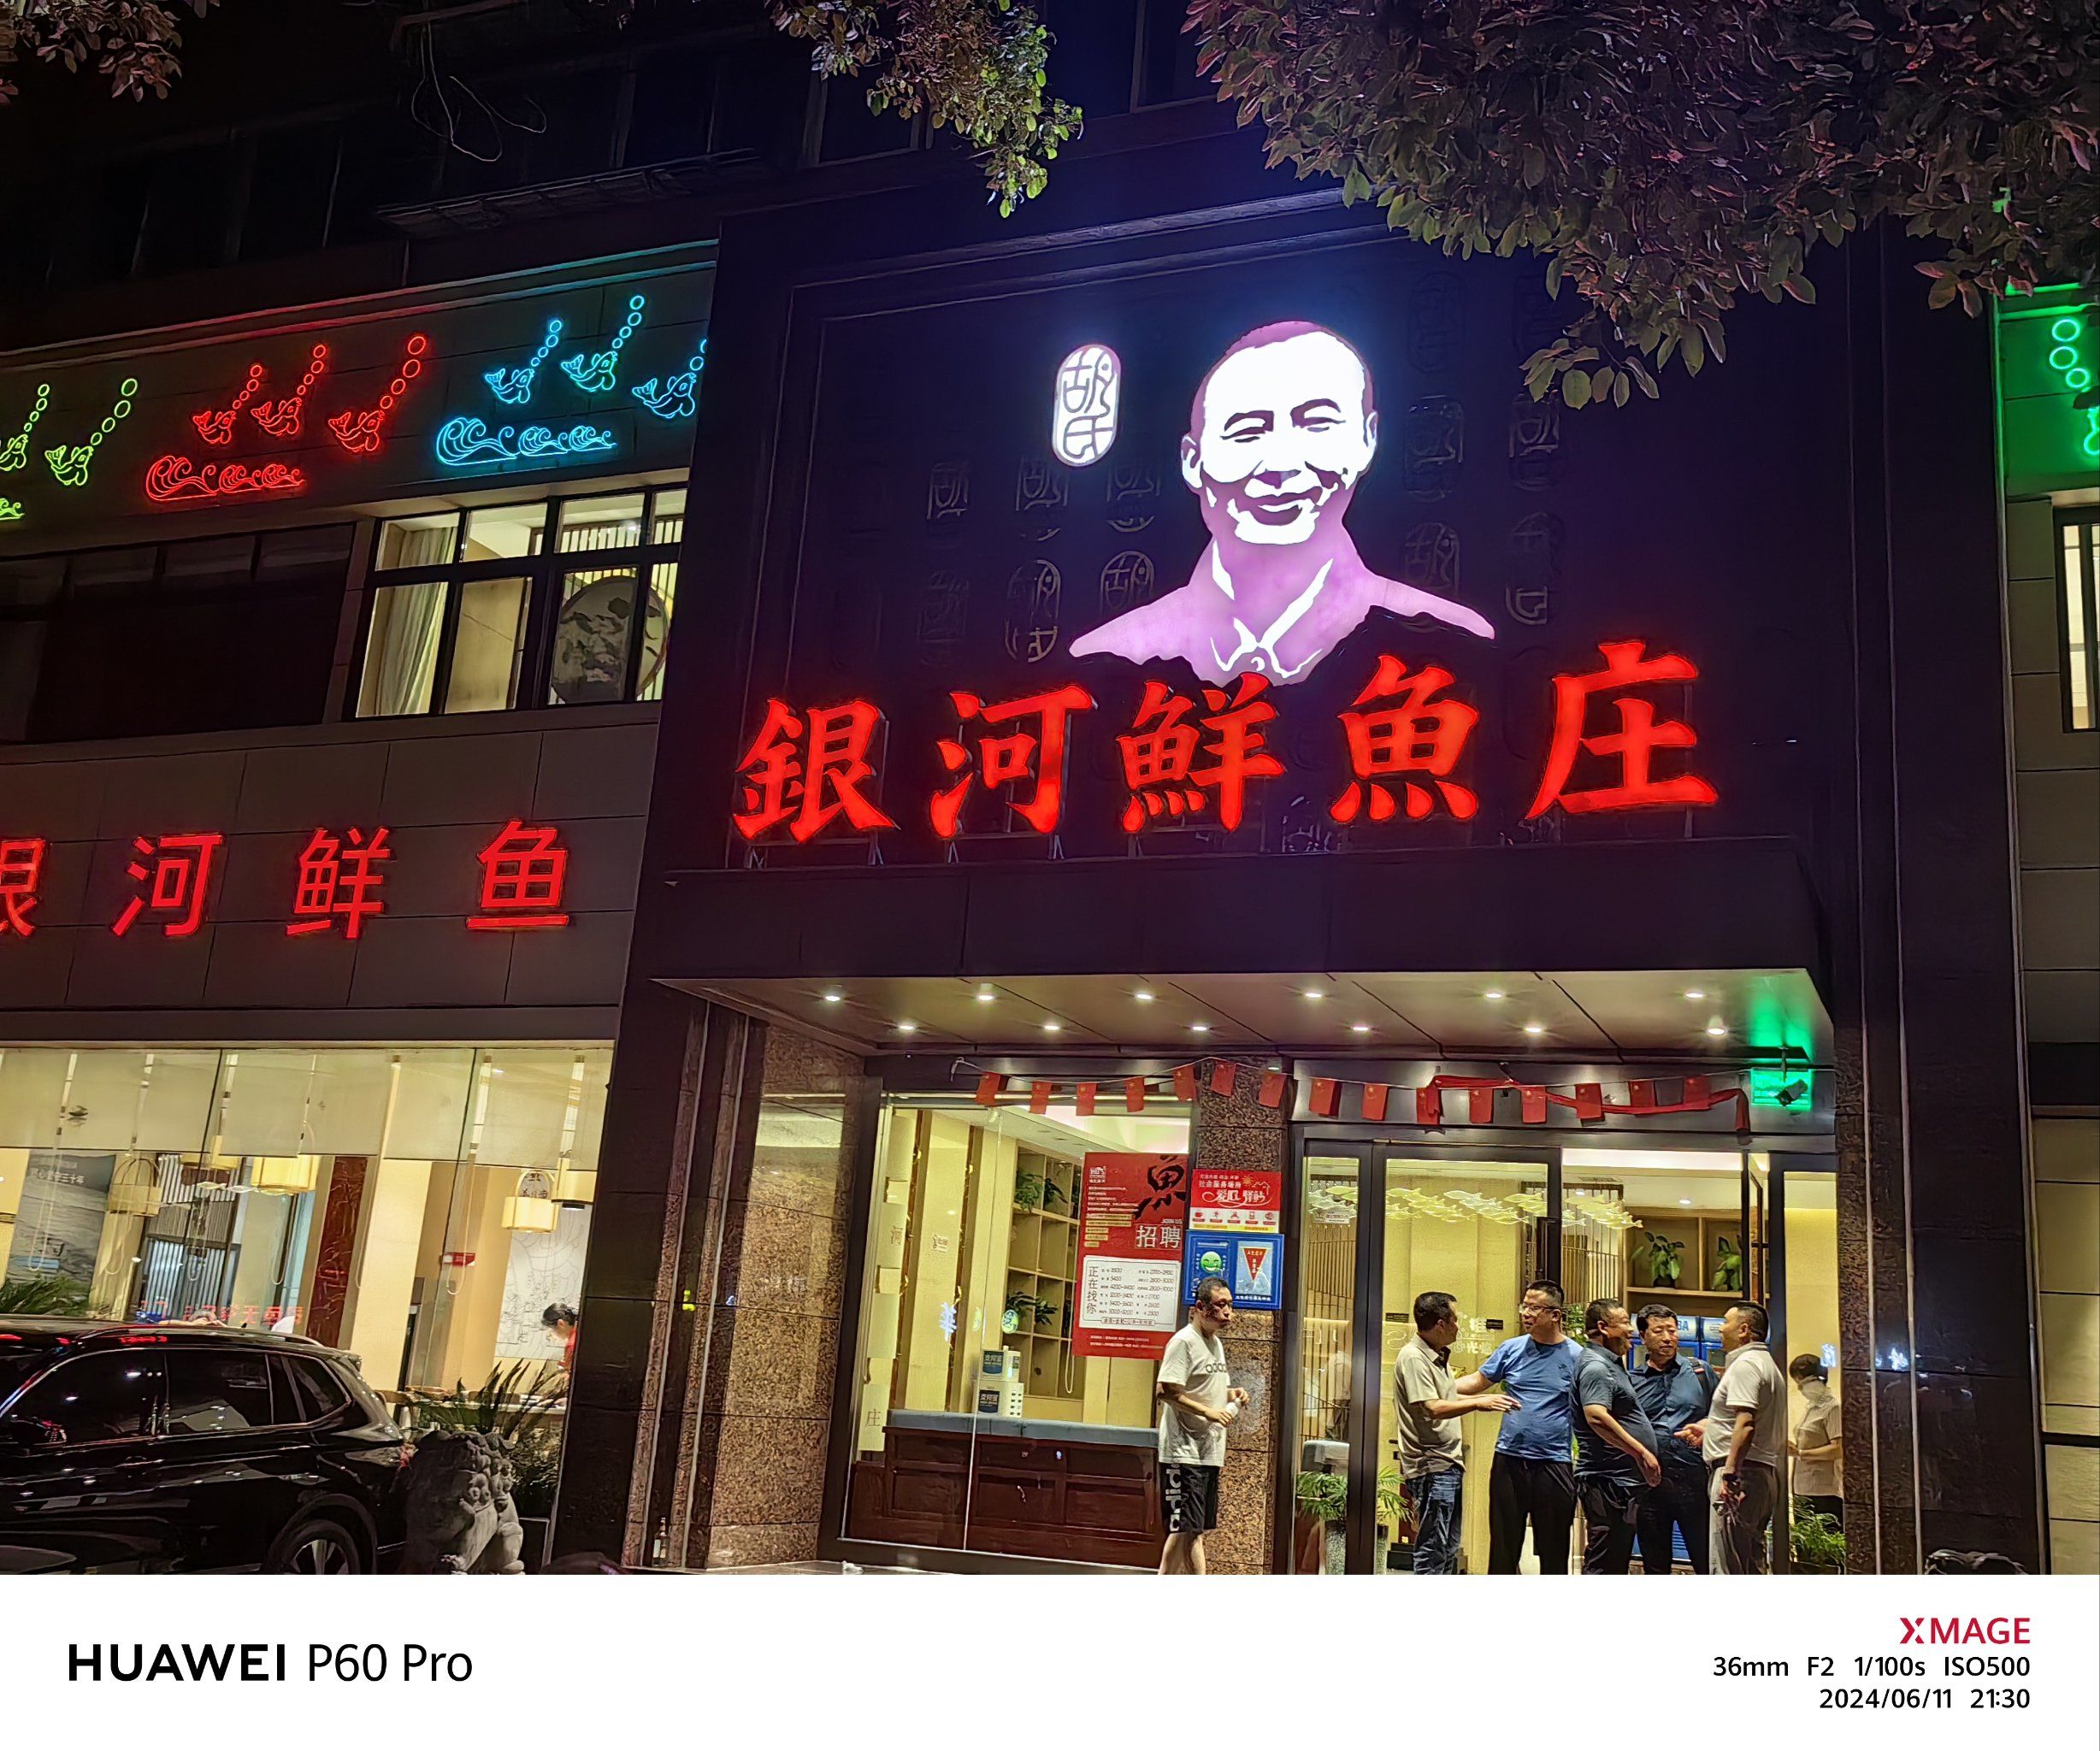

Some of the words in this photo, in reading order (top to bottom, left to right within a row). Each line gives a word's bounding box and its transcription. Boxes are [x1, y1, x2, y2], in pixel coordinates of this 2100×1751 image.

[735, 643, 1716, 841] 銀河鮮魚庄
[1136, 1224, 1181, 1248] 招聘
